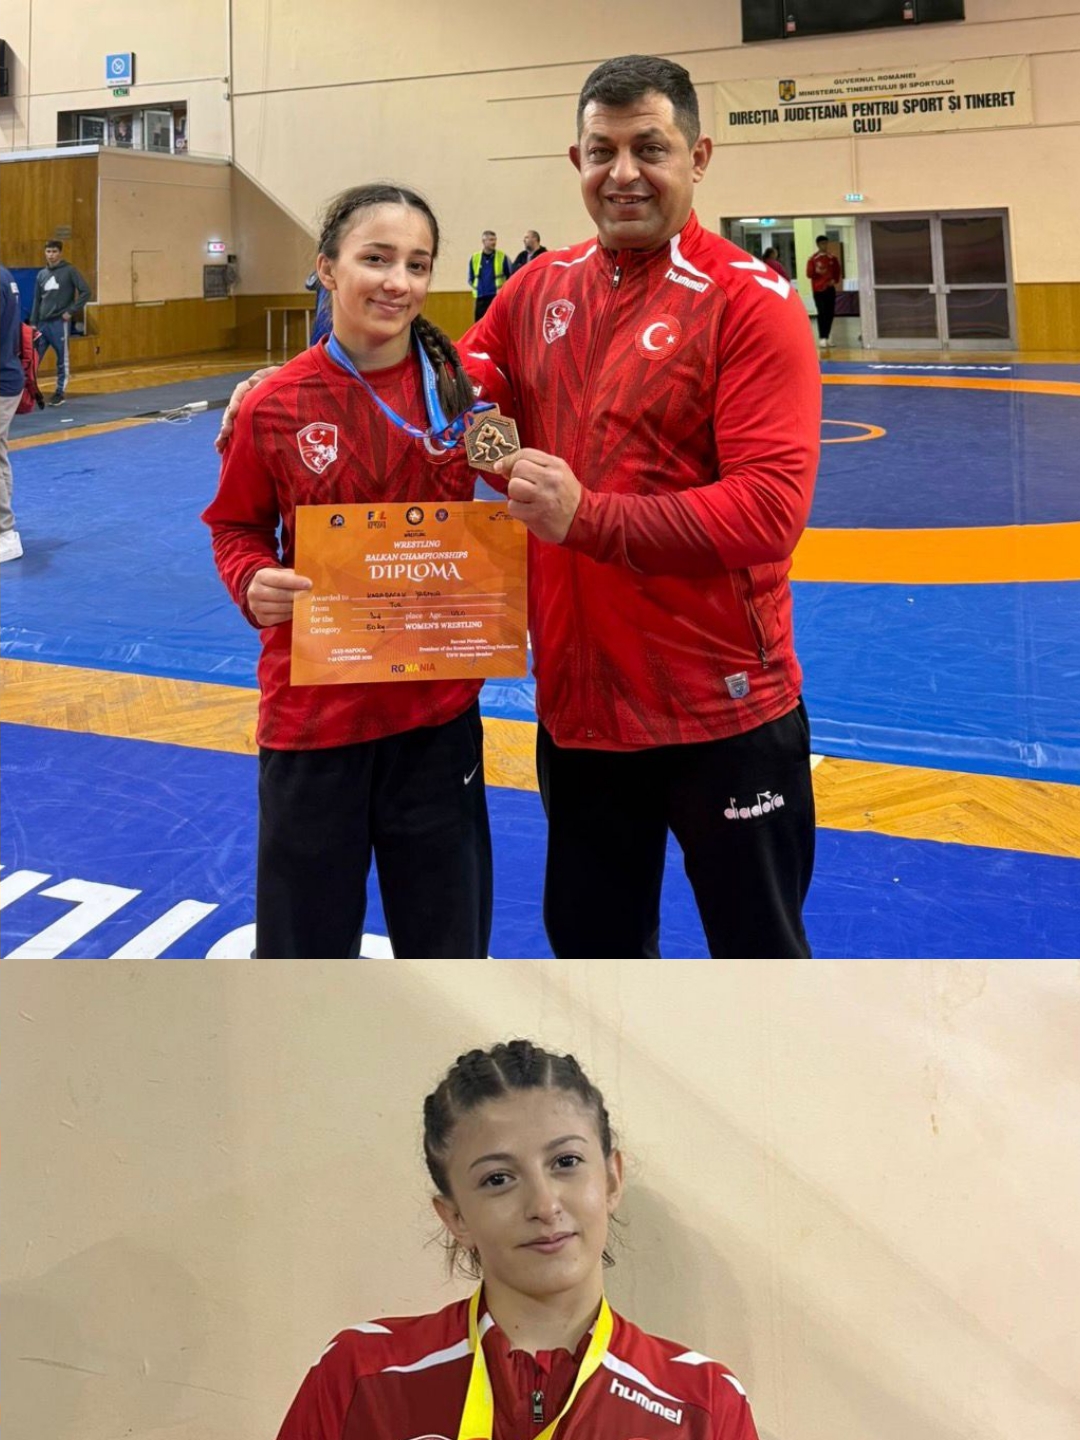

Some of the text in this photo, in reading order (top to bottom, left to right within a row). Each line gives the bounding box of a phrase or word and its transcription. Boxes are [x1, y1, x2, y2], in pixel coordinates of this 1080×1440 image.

[851, 99, 899, 118] PENTRU
[902, 96, 943, 115] SPORT
[964, 91, 1016, 110] TINERET
[852, 118, 882, 134] CLUJ
[665, 267, 709, 293] hummel
[369, 561, 464, 583] DIPLOMA
[391, 663, 436, 674] ROMANIA
[723, 790, 785, 820] diadora
[609, 1377, 683, 1426] hummel
